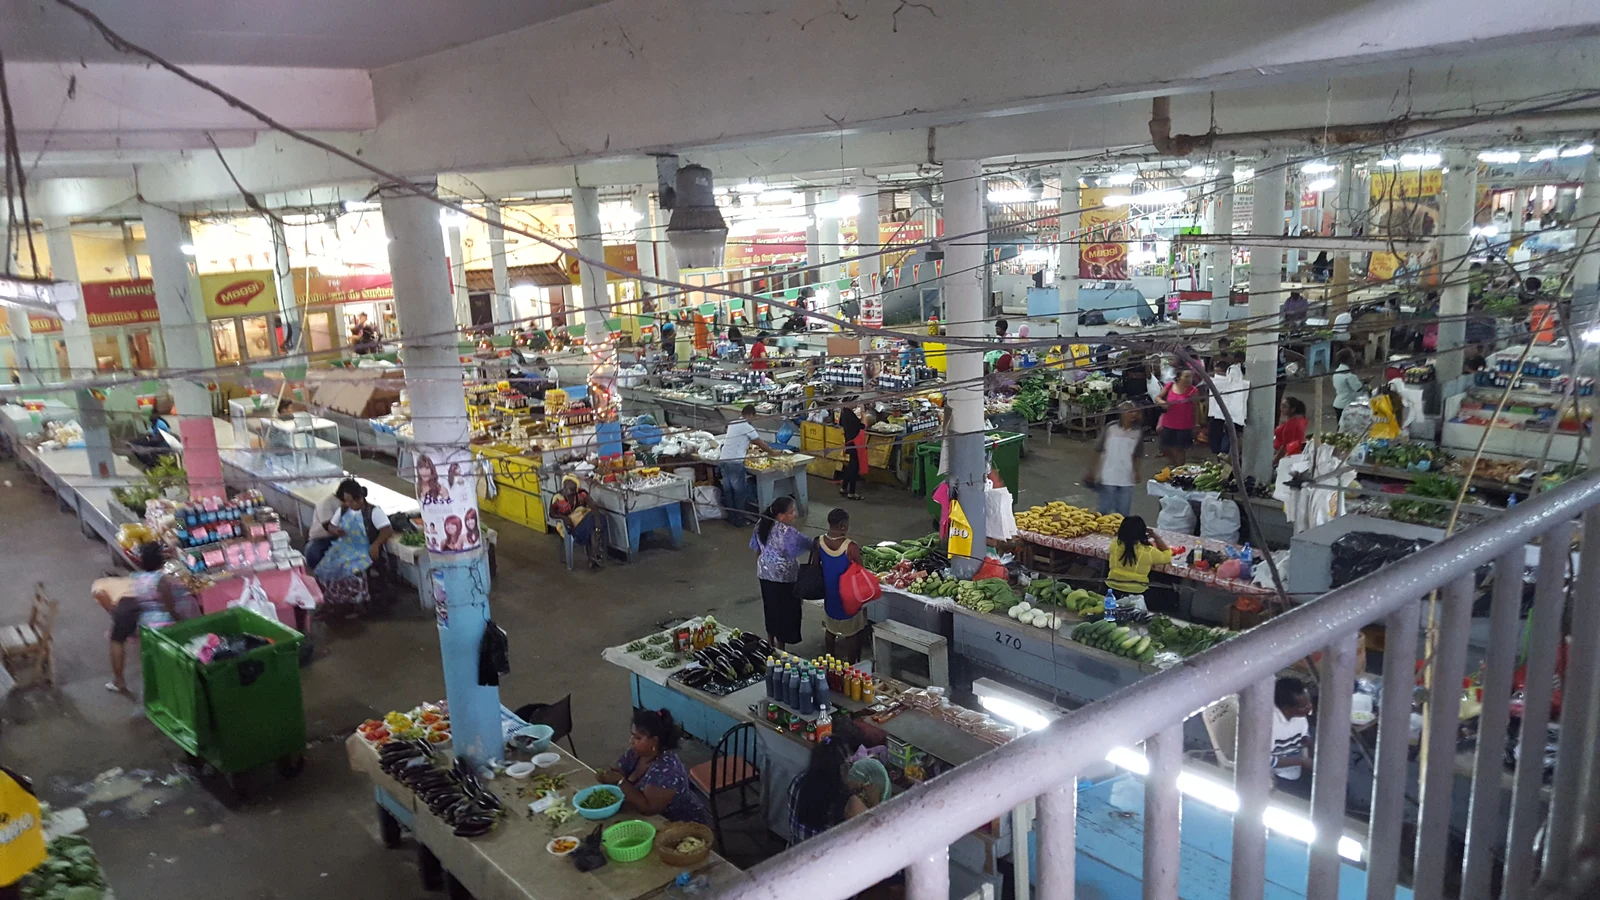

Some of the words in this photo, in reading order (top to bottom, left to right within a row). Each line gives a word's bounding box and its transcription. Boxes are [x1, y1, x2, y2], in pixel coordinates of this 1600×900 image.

[1088, 246, 1118, 258] Maggi
[220, 283, 259, 303] Maggi
[422, 493, 452, 509] Best
[995, 631, 1022, 650] 270
